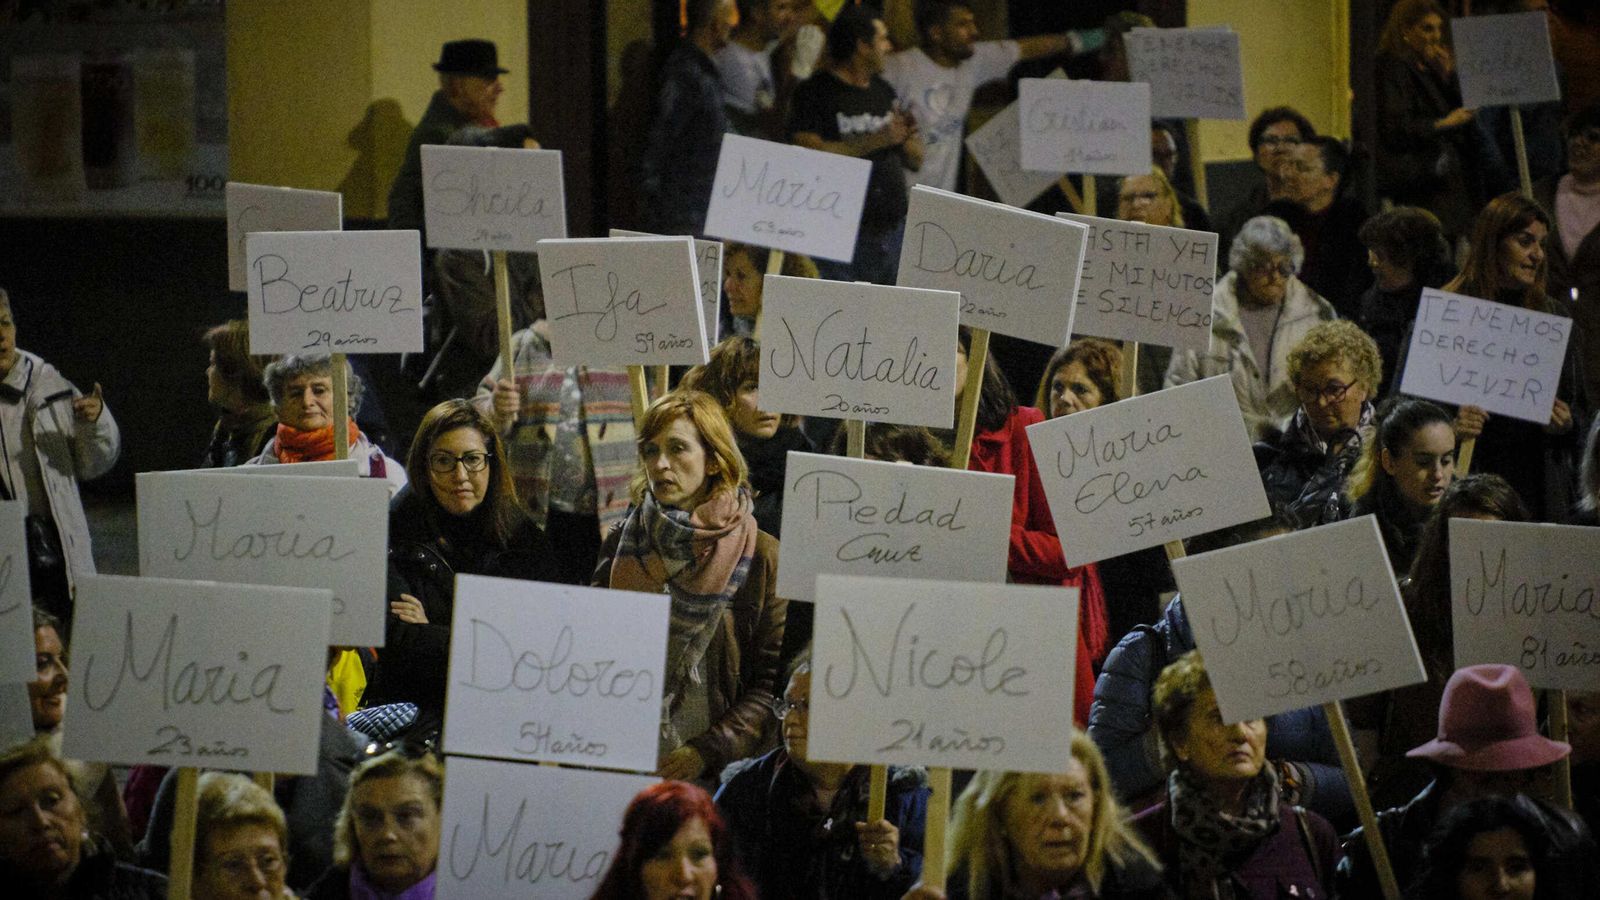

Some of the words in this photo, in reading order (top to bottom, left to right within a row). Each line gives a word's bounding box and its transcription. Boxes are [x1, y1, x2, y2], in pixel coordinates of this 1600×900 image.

[184, 174, 225, 192] 100
[431, 169, 553, 218] Sheila
[722, 155, 843, 220] Maria
[912, 221, 1045, 290] Daria
[1087, 225, 1151, 254] ASTA
[1168, 235, 1210, 265] YA
[252, 253, 416, 315] Beatriz
[550, 262, 668, 342] Ifa
[1108, 260, 1213, 297] MINUTOS
[301, 329, 332, 349] 29
[333, 333, 379, 347] años
[634, 331, 655, 354] 59
[658, 333, 694, 350] años
[1423, 294, 1564, 343] TENEMOS
[769, 308, 941, 391] Natalia
[1419, 329, 1540, 367] DERECHO
[821, 393, 850, 412] 20
[852, 402, 890, 415] años
[1439, 362, 1543, 406] VIVIR
[1056, 418, 1183, 479] Maria
[792, 469, 967, 532] Piedad
[1074, 466, 1209, 515] Elena
[173, 496, 357, 562] Maria
[1128, 512, 1156, 538] 57
[1161, 506, 1204, 527] años
[1210, 568, 1380, 647] Maria
[1465, 547, 1600, 621] Maria
[82, 608, 295, 714] Maria
[458, 617, 655, 702] Dolores
[823, 601, 1031, 700] Nicole
[1520, 635, 1548, 669] 81
[1555, 641, 1600, 667] año
[1266, 658, 1311, 699] 58
[1314, 658, 1383, 689] años
[146, 725, 192, 756] 23
[196, 740, 250, 757] años
[551, 733, 608, 757] años
[876, 718, 926, 753] 21
[928, 727, 1006, 756] años
[448, 792, 609, 885] Maria
